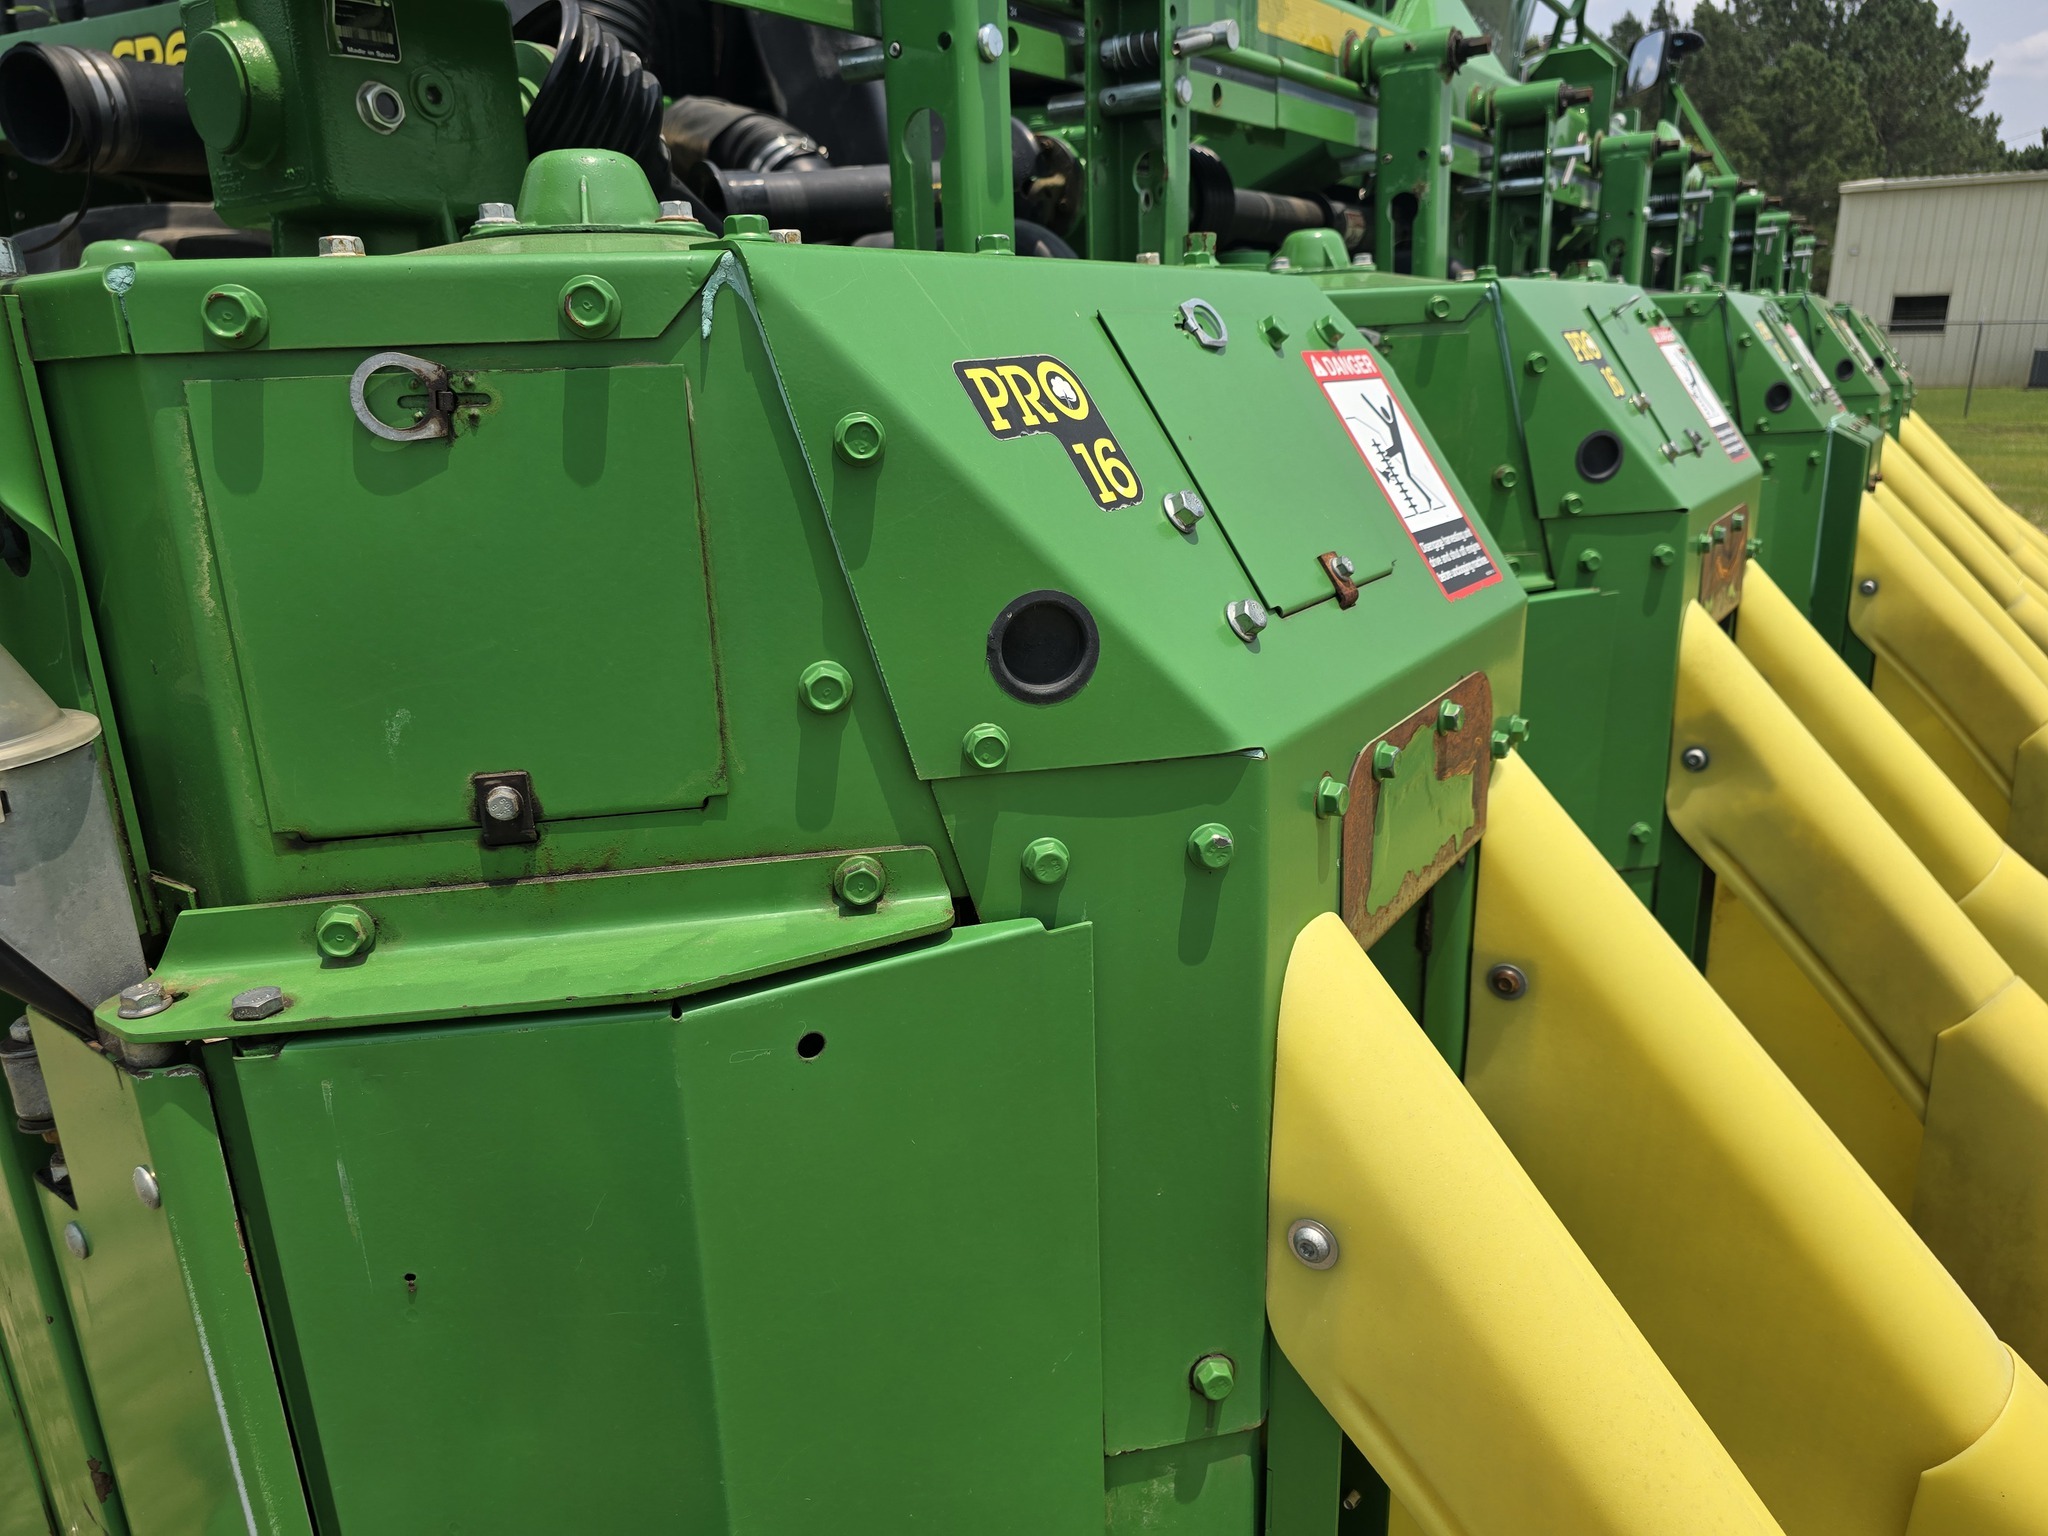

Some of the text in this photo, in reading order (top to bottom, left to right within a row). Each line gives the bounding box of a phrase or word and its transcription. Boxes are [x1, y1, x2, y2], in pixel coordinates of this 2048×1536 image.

[964, 361, 1090, 432] PRO
[1321, 354, 1378, 377] DANGER
[1072, 437, 1139, 504] 16
